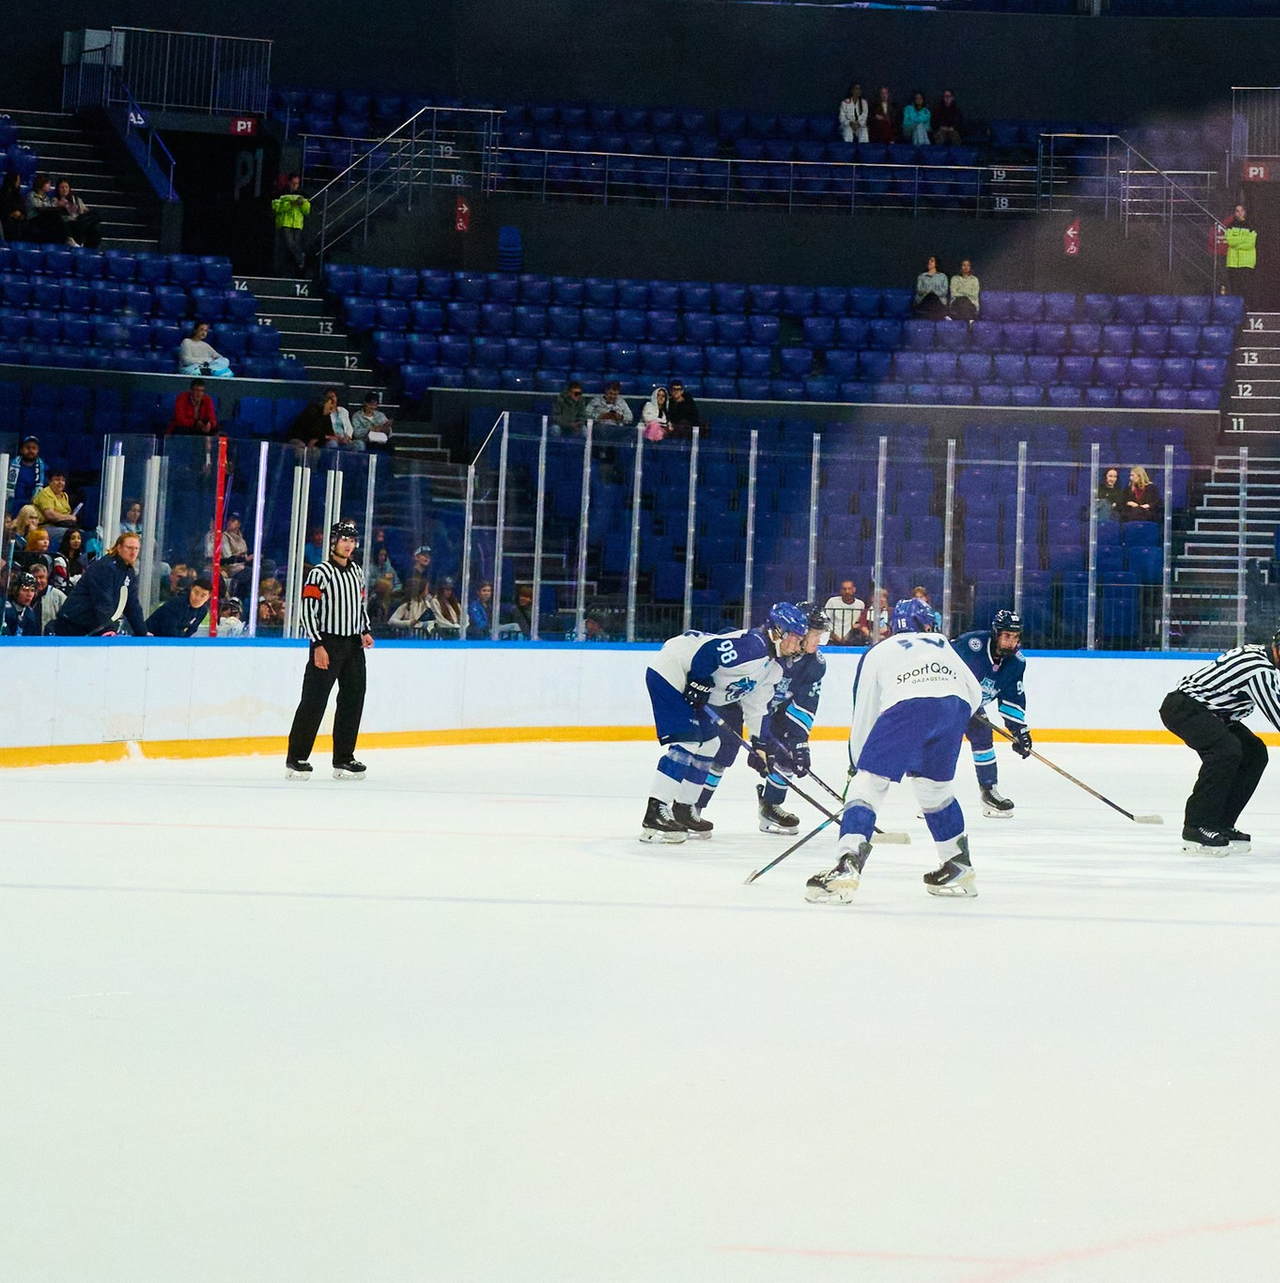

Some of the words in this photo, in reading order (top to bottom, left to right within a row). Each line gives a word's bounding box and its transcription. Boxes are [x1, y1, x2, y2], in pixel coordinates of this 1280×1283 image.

[236, 120, 252, 133] P1
[992, 170, 1006, 180] 19
[1250, 167, 1265, 178] P1
[994, 197, 1009, 208] 18
[233, 280, 248, 291] 14
[295, 284, 309, 297] 14
[319, 321, 333, 334] 13
[1249, 318, 1264, 330] 14
[344, 355, 358, 368] 12
[1243, 352, 1258, 364] 13
[1238, 384, 1253, 396] 12
[1232, 418, 1244, 430] 11
[897, 618, 907, 628] 16
[717, 639, 738, 664] 98
